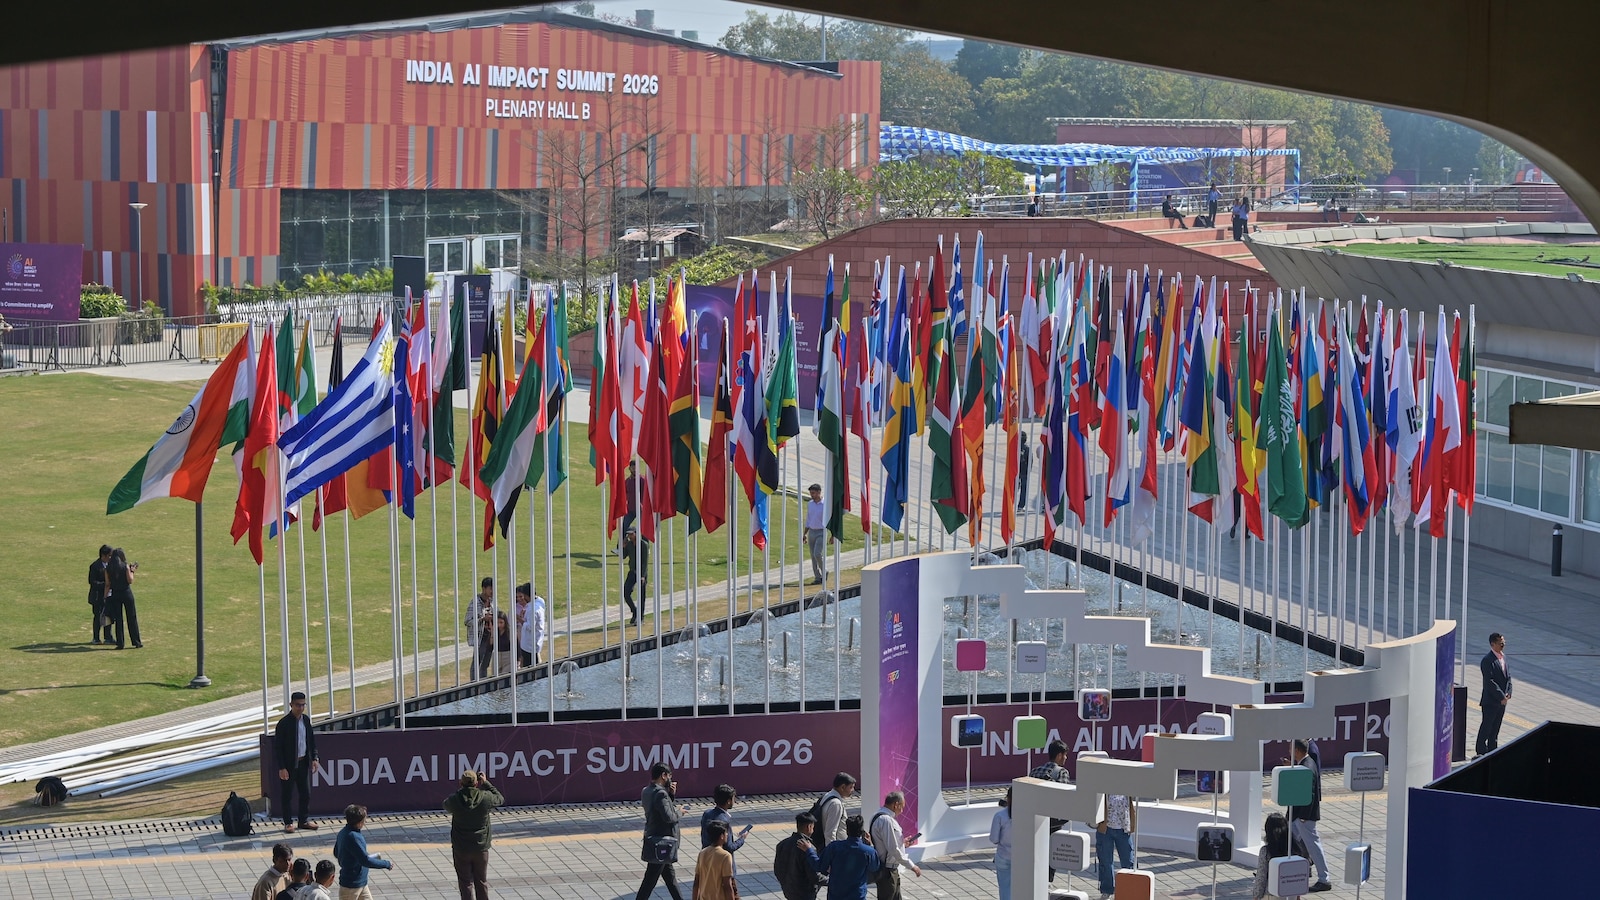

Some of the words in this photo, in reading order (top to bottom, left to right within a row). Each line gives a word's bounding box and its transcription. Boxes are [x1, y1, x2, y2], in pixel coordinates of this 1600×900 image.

[406, 60, 454, 83] INDIA
[463, 64, 480, 85] AI
[488, 65, 549, 88] IMPACT
[557, 69, 615, 92] SUMMIT
[623, 74, 659, 94] 2026
[486, 98, 545, 118] PLENARY
[548, 101, 579, 119] HALL
[582, 102, 590, 119] B
[25, 258, 33, 266] AI
[893, 613, 900, 624] AI
[981, 728, 1062, 756] INA
[1073, 726, 1103, 752] AI
[312, 757, 396, 787] NDIA
[405, 755, 438, 783] AI
[449, 748, 577, 781] IMPACT
[587, 742, 722, 774] SUMMIT
[731, 738, 813, 767] 2026
